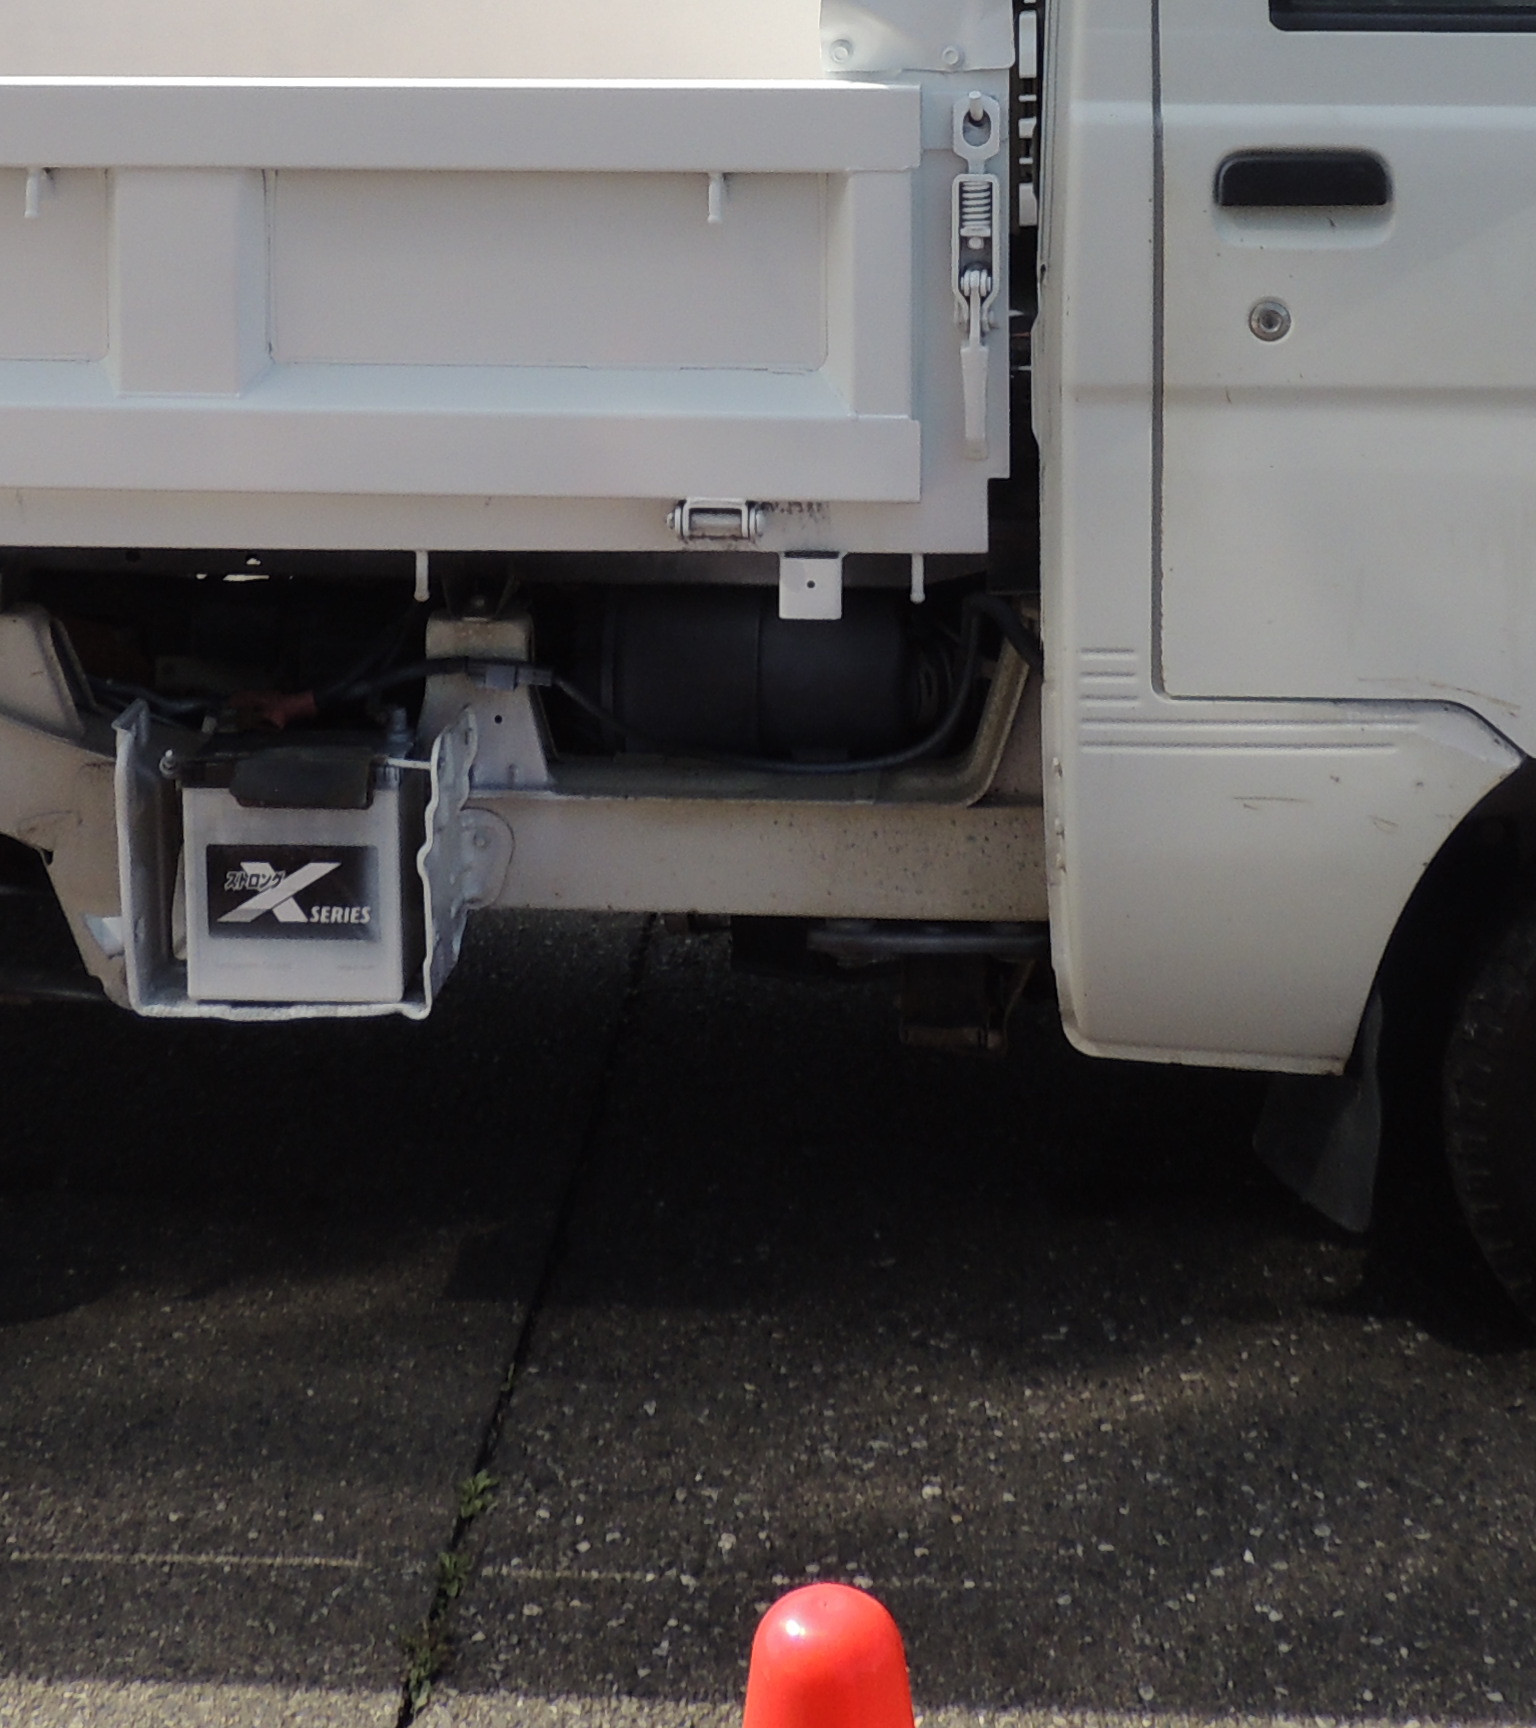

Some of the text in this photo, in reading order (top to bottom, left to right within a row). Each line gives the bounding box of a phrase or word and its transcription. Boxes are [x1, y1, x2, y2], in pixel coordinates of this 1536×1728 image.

[216, 862, 371, 924] X SERIES
[224, 871, 286, 892] ストロング
